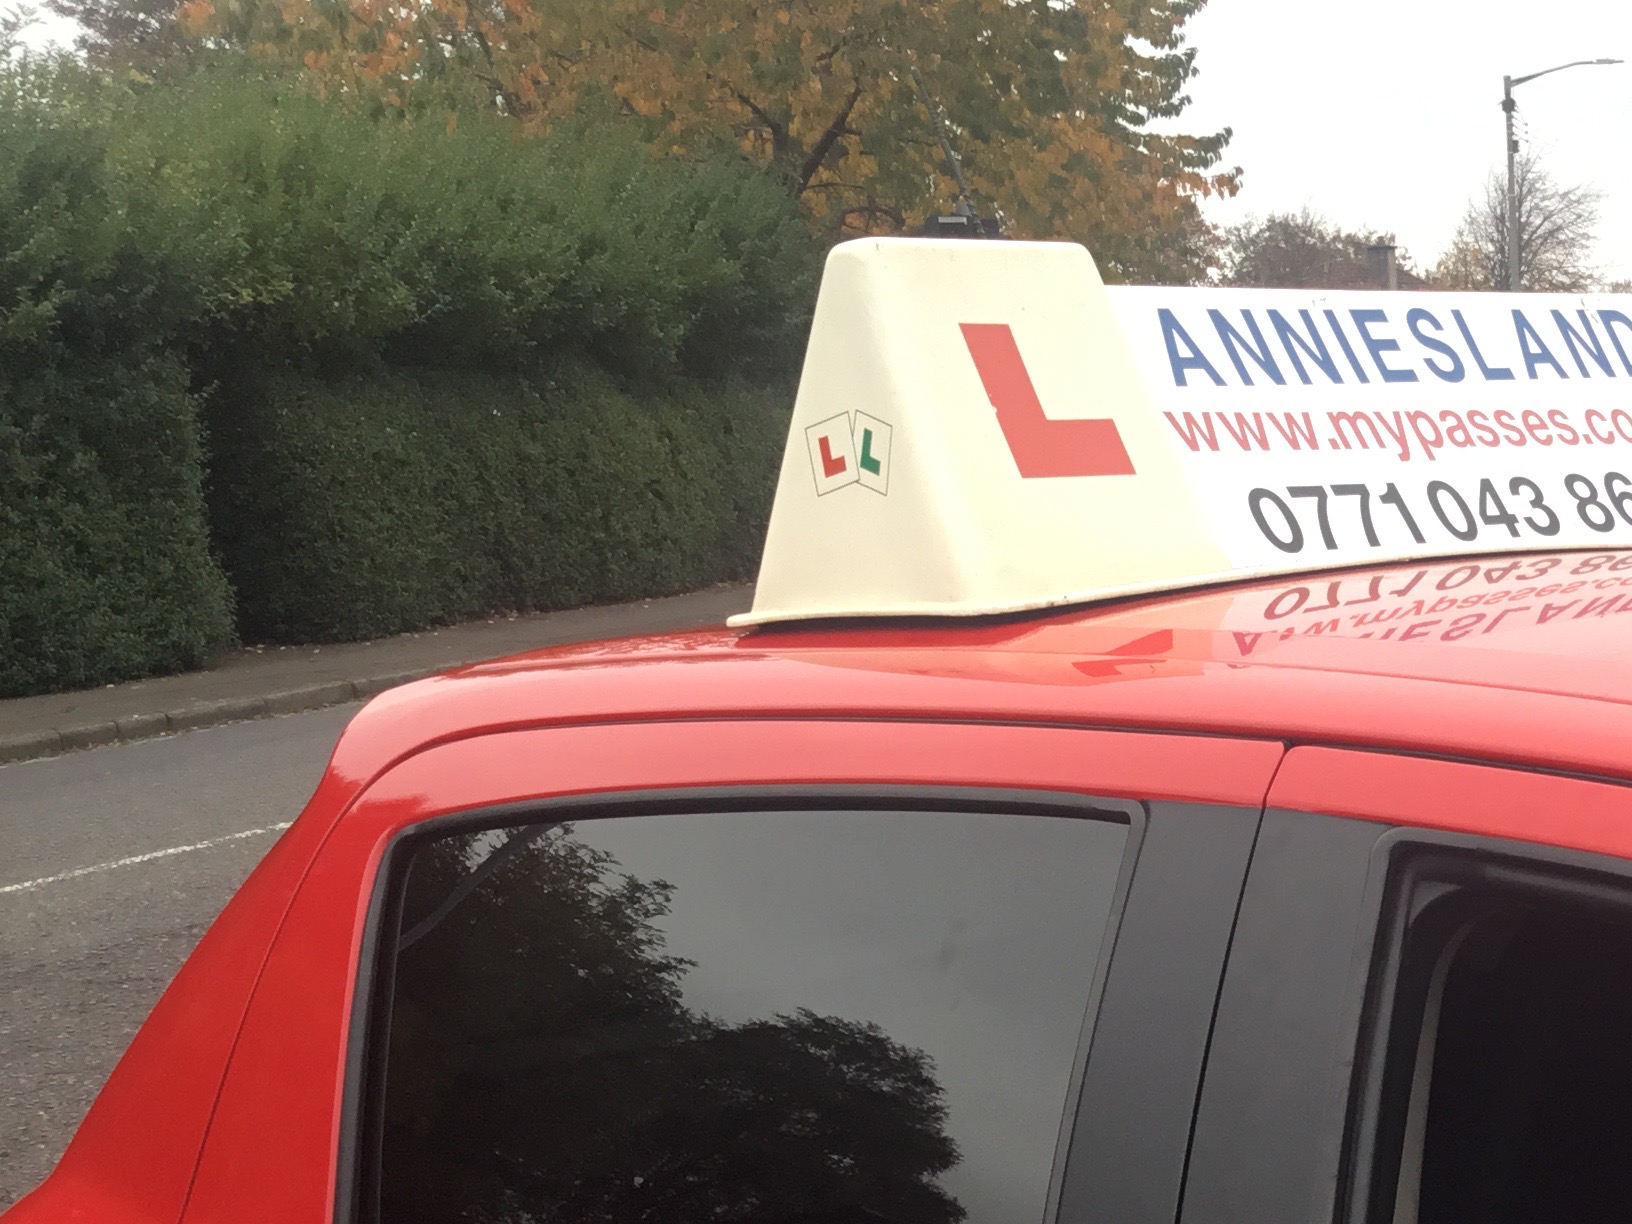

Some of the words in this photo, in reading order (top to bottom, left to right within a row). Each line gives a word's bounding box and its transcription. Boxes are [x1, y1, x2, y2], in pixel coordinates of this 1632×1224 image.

[958, 322, 1137, 479] L
[818, 435, 847, 478] L
[859, 427, 881, 476] L
[1247, 482, 1427, 554] 0771
[1426, 476, 1561, 542] 043
